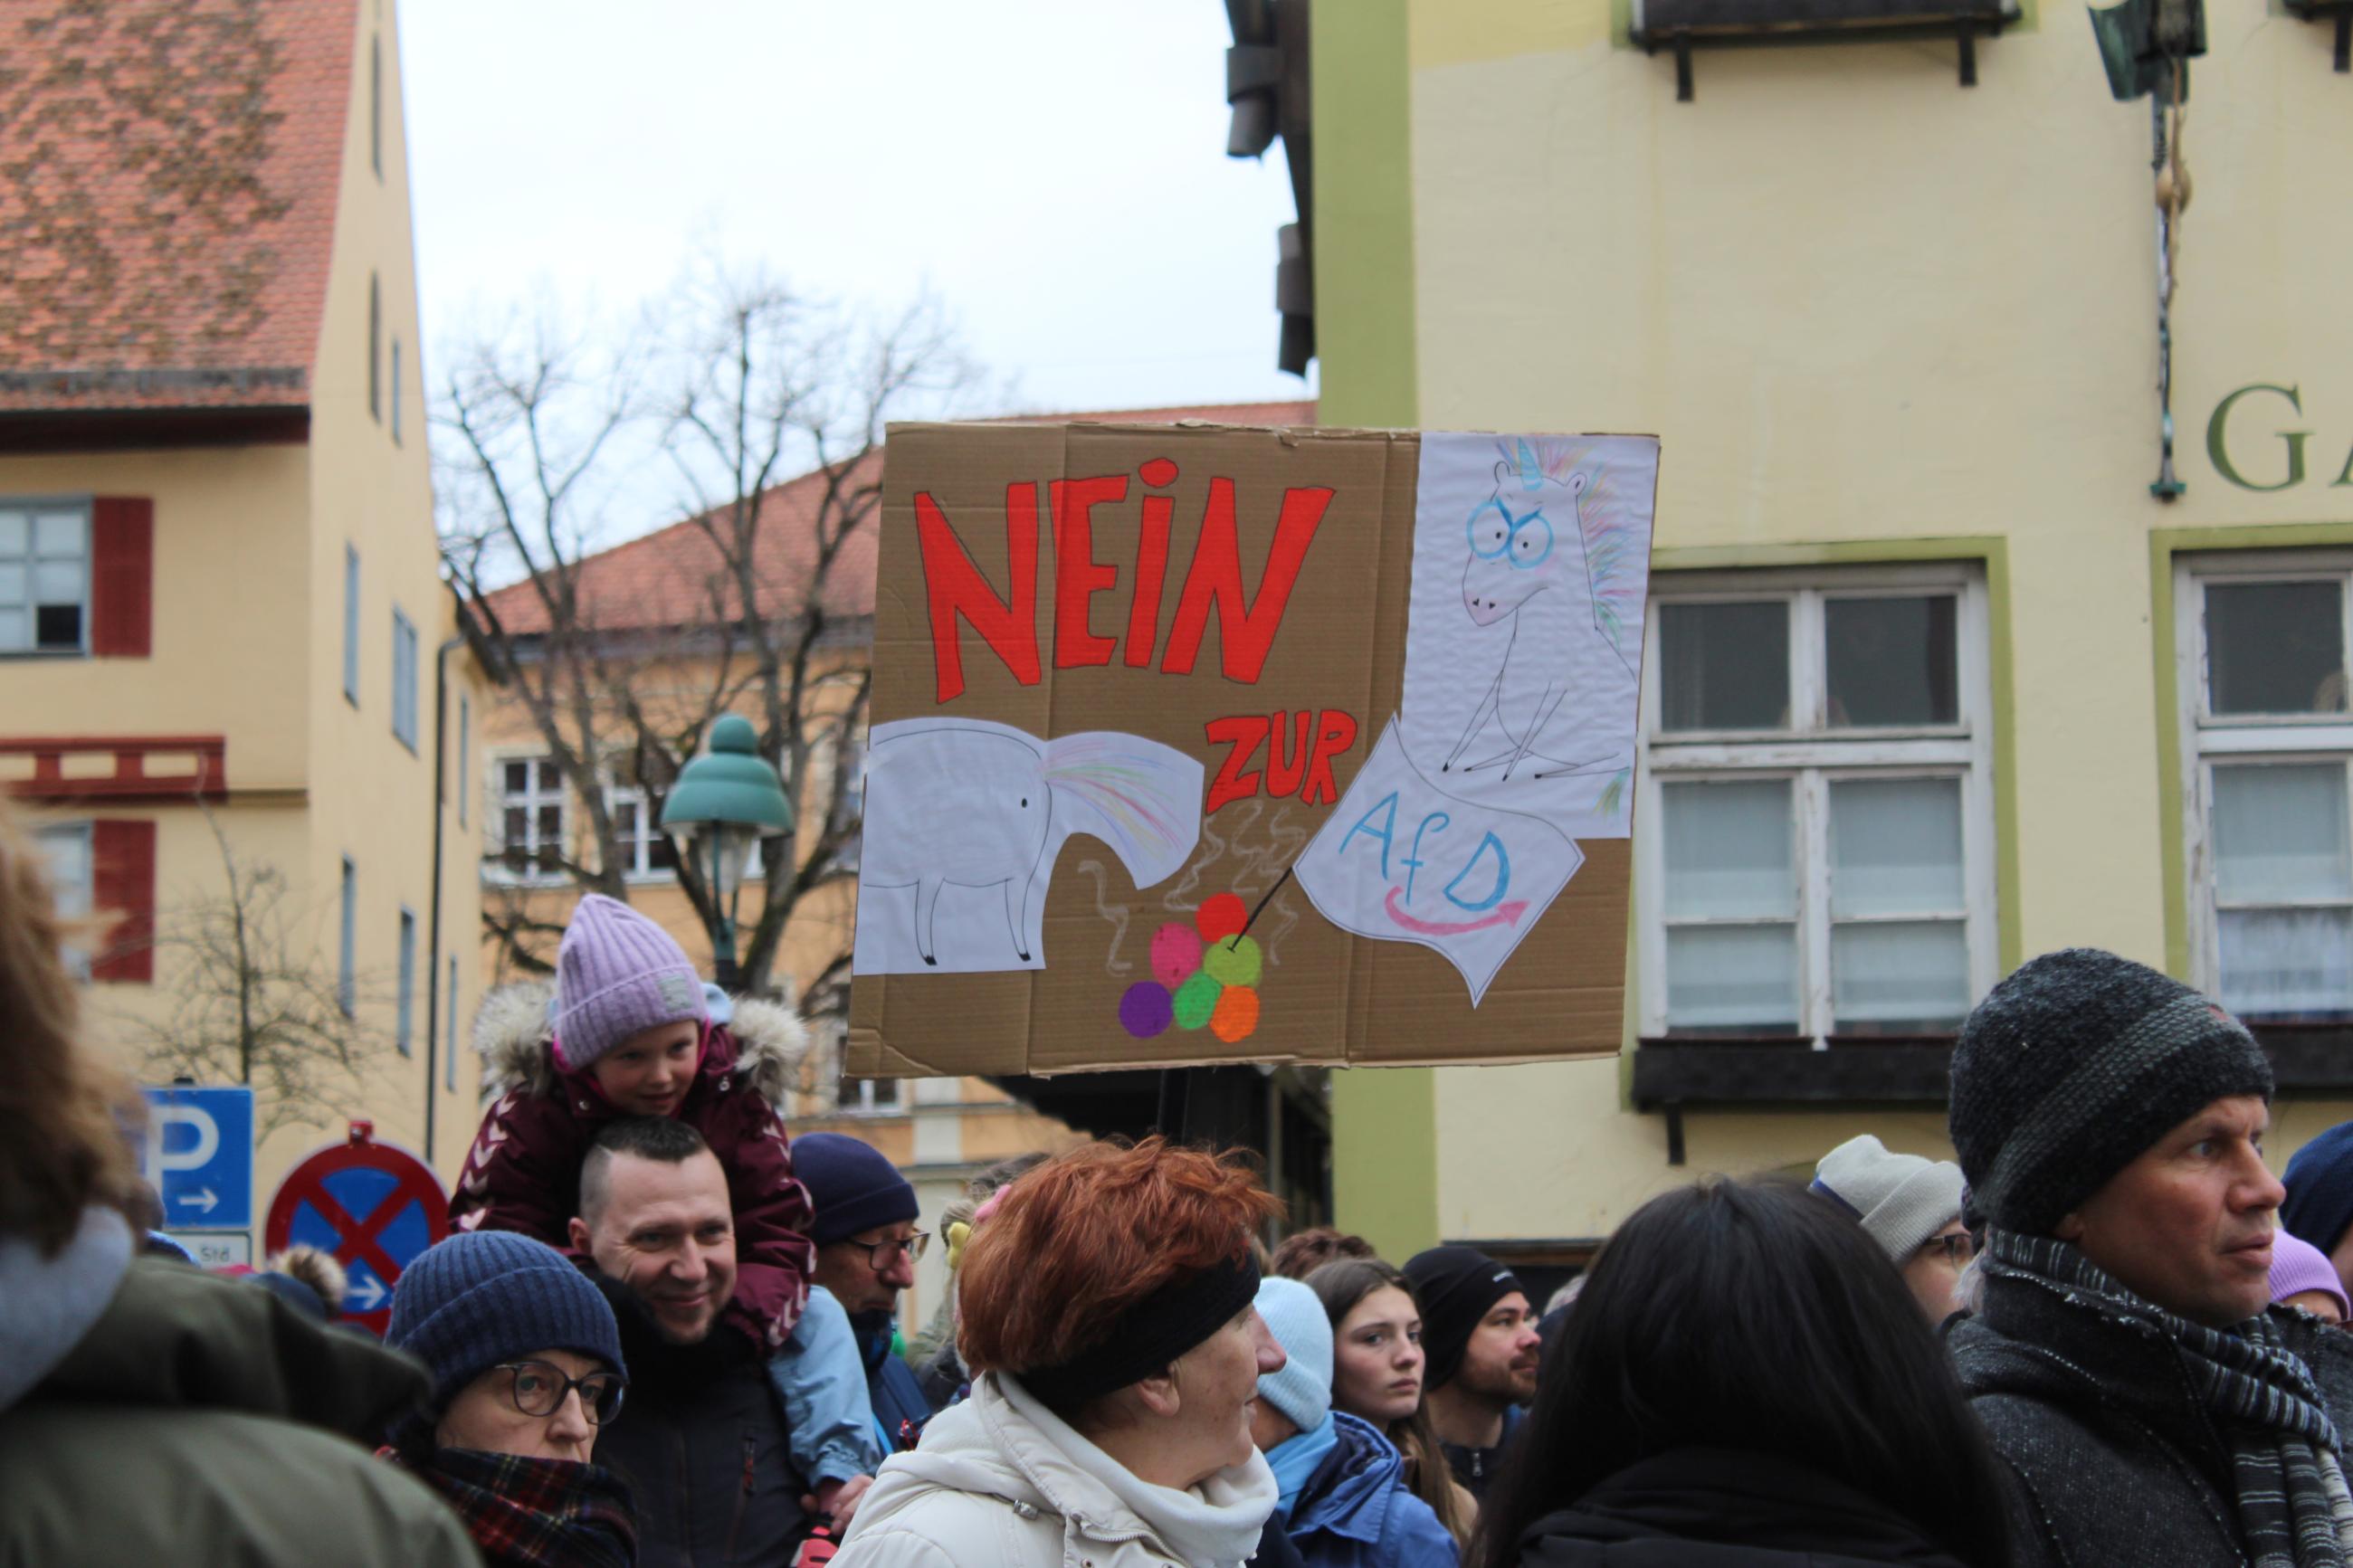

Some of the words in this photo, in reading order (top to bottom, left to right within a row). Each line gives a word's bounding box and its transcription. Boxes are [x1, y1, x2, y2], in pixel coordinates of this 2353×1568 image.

[1205, 708, 1358, 815] ZUR
[1338, 791, 1511, 912] AfD
[146, 1104, 220, 1203] P
